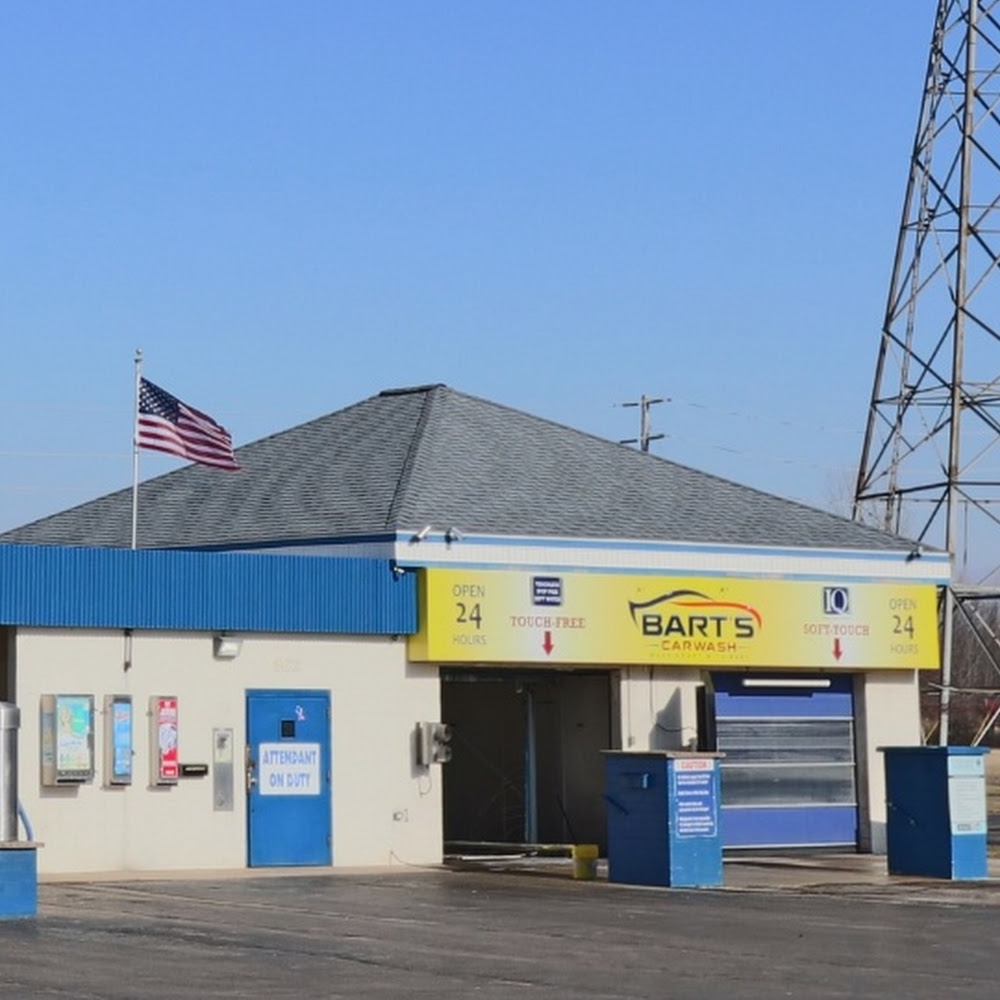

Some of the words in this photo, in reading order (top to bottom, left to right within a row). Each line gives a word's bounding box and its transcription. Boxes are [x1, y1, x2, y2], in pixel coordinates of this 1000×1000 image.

[452, 584, 485, 598] OPEN
[889, 598, 917, 611] OPEN
[456, 602, 482, 630] 24
[510, 616, 586, 629] TOUCH-FREE
[642, 614, 755, 638] BART'S
[803, 623, 870, 636] SOFT-TOUCH
[892, 614, 914, 639] 24
[453, 634, 487, 646] HOURS
[660, 639, 737, 653] CARWASH
[263, 749, 317, 766] ATTENDANT
[269, 772, 285, 788] ON
[287, 772, 312, 788] DUTY
